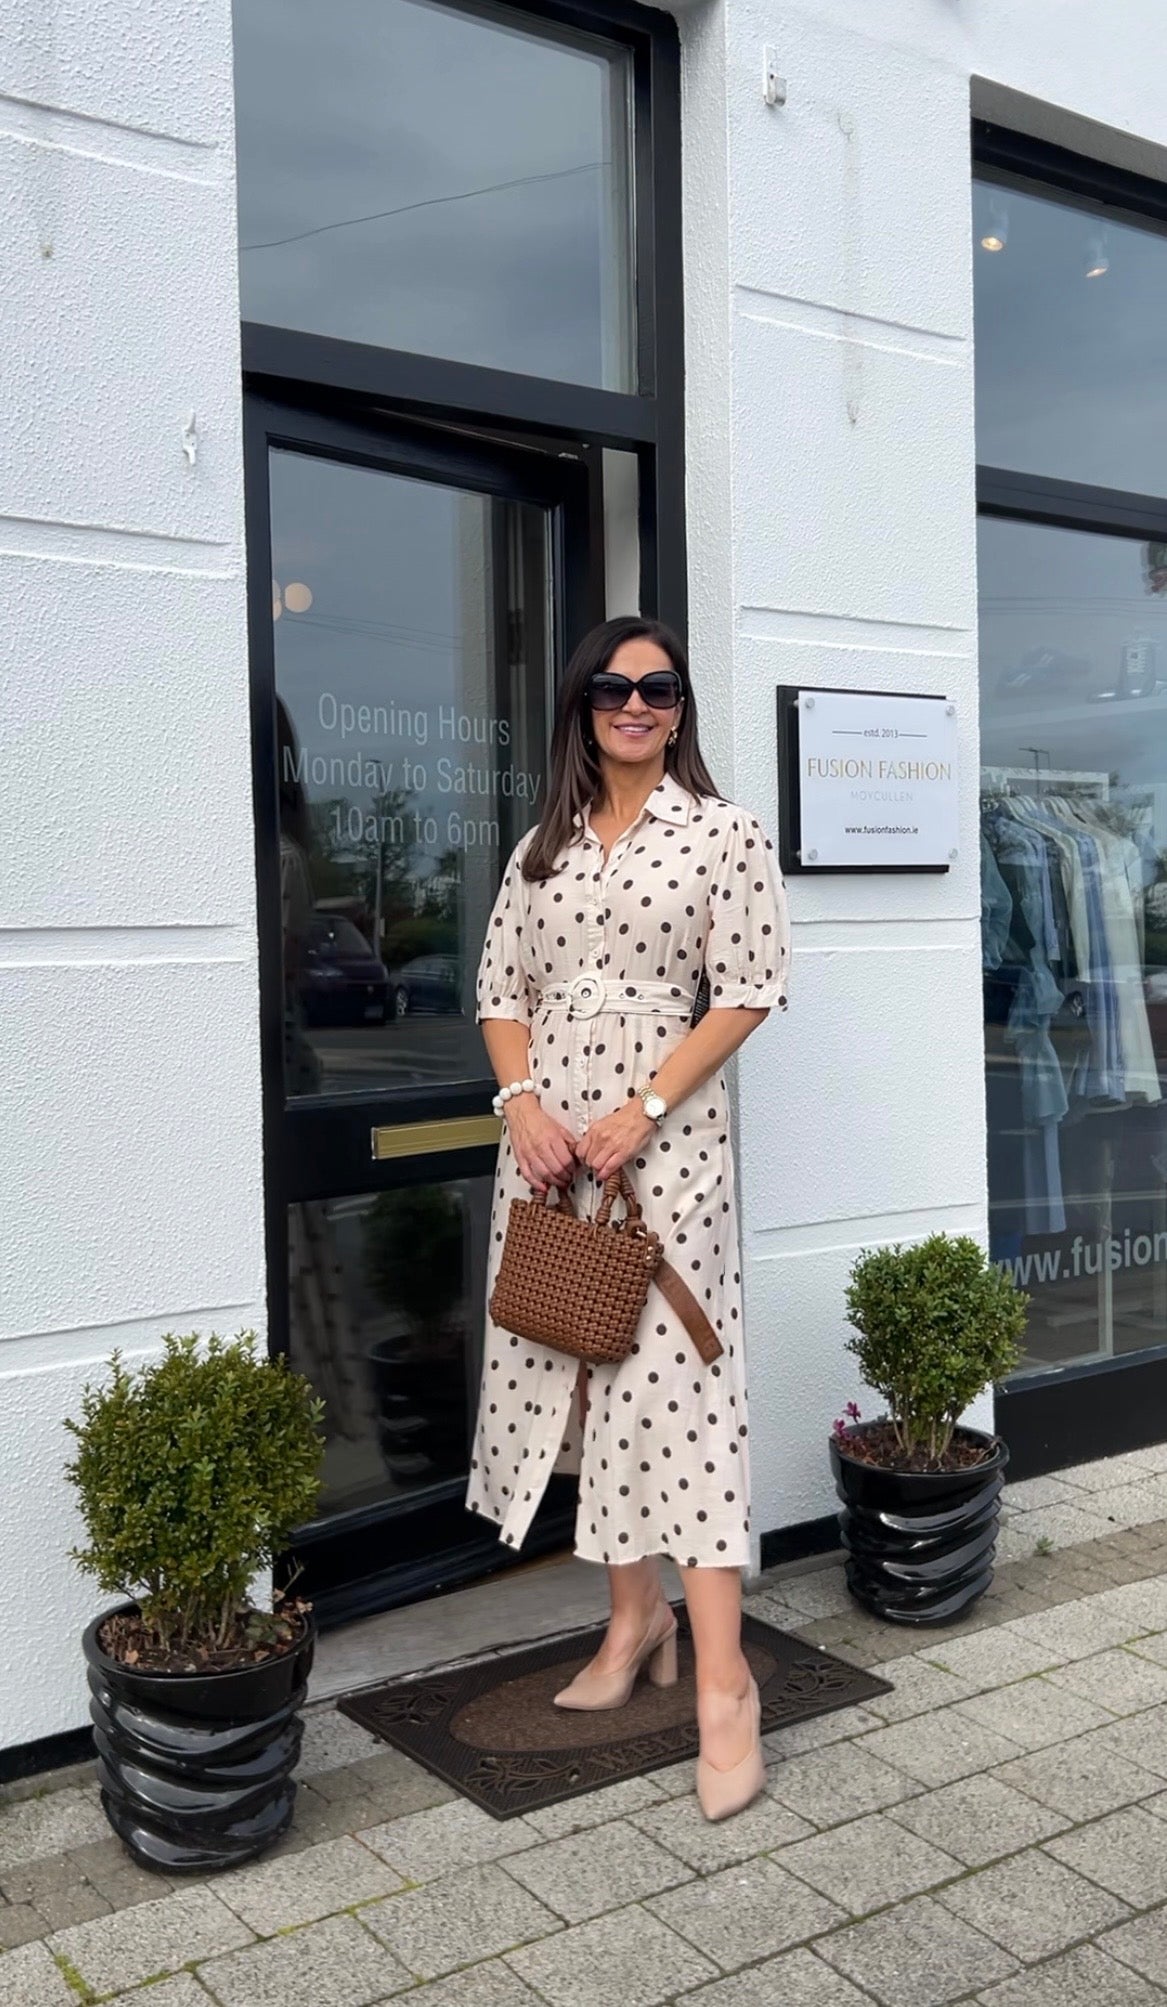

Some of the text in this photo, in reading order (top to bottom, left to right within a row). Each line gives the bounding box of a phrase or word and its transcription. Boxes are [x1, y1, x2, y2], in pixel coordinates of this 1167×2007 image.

[318, 693, 510, 746] Opening Hours
[881, 728, 898, 739] 2013
[282, 745, 541, 805] Monday to Saturday
[807, 757, 951, 781] FUSION FASHION
[850, 790, 913, 802] MOYCULLEN
[331, 806, 500, 853] 10am to 6pm
[844, 825, 919, 835] www.fusionfashion.ie
[998, 1228, 1167, 1287] ww.fusion
